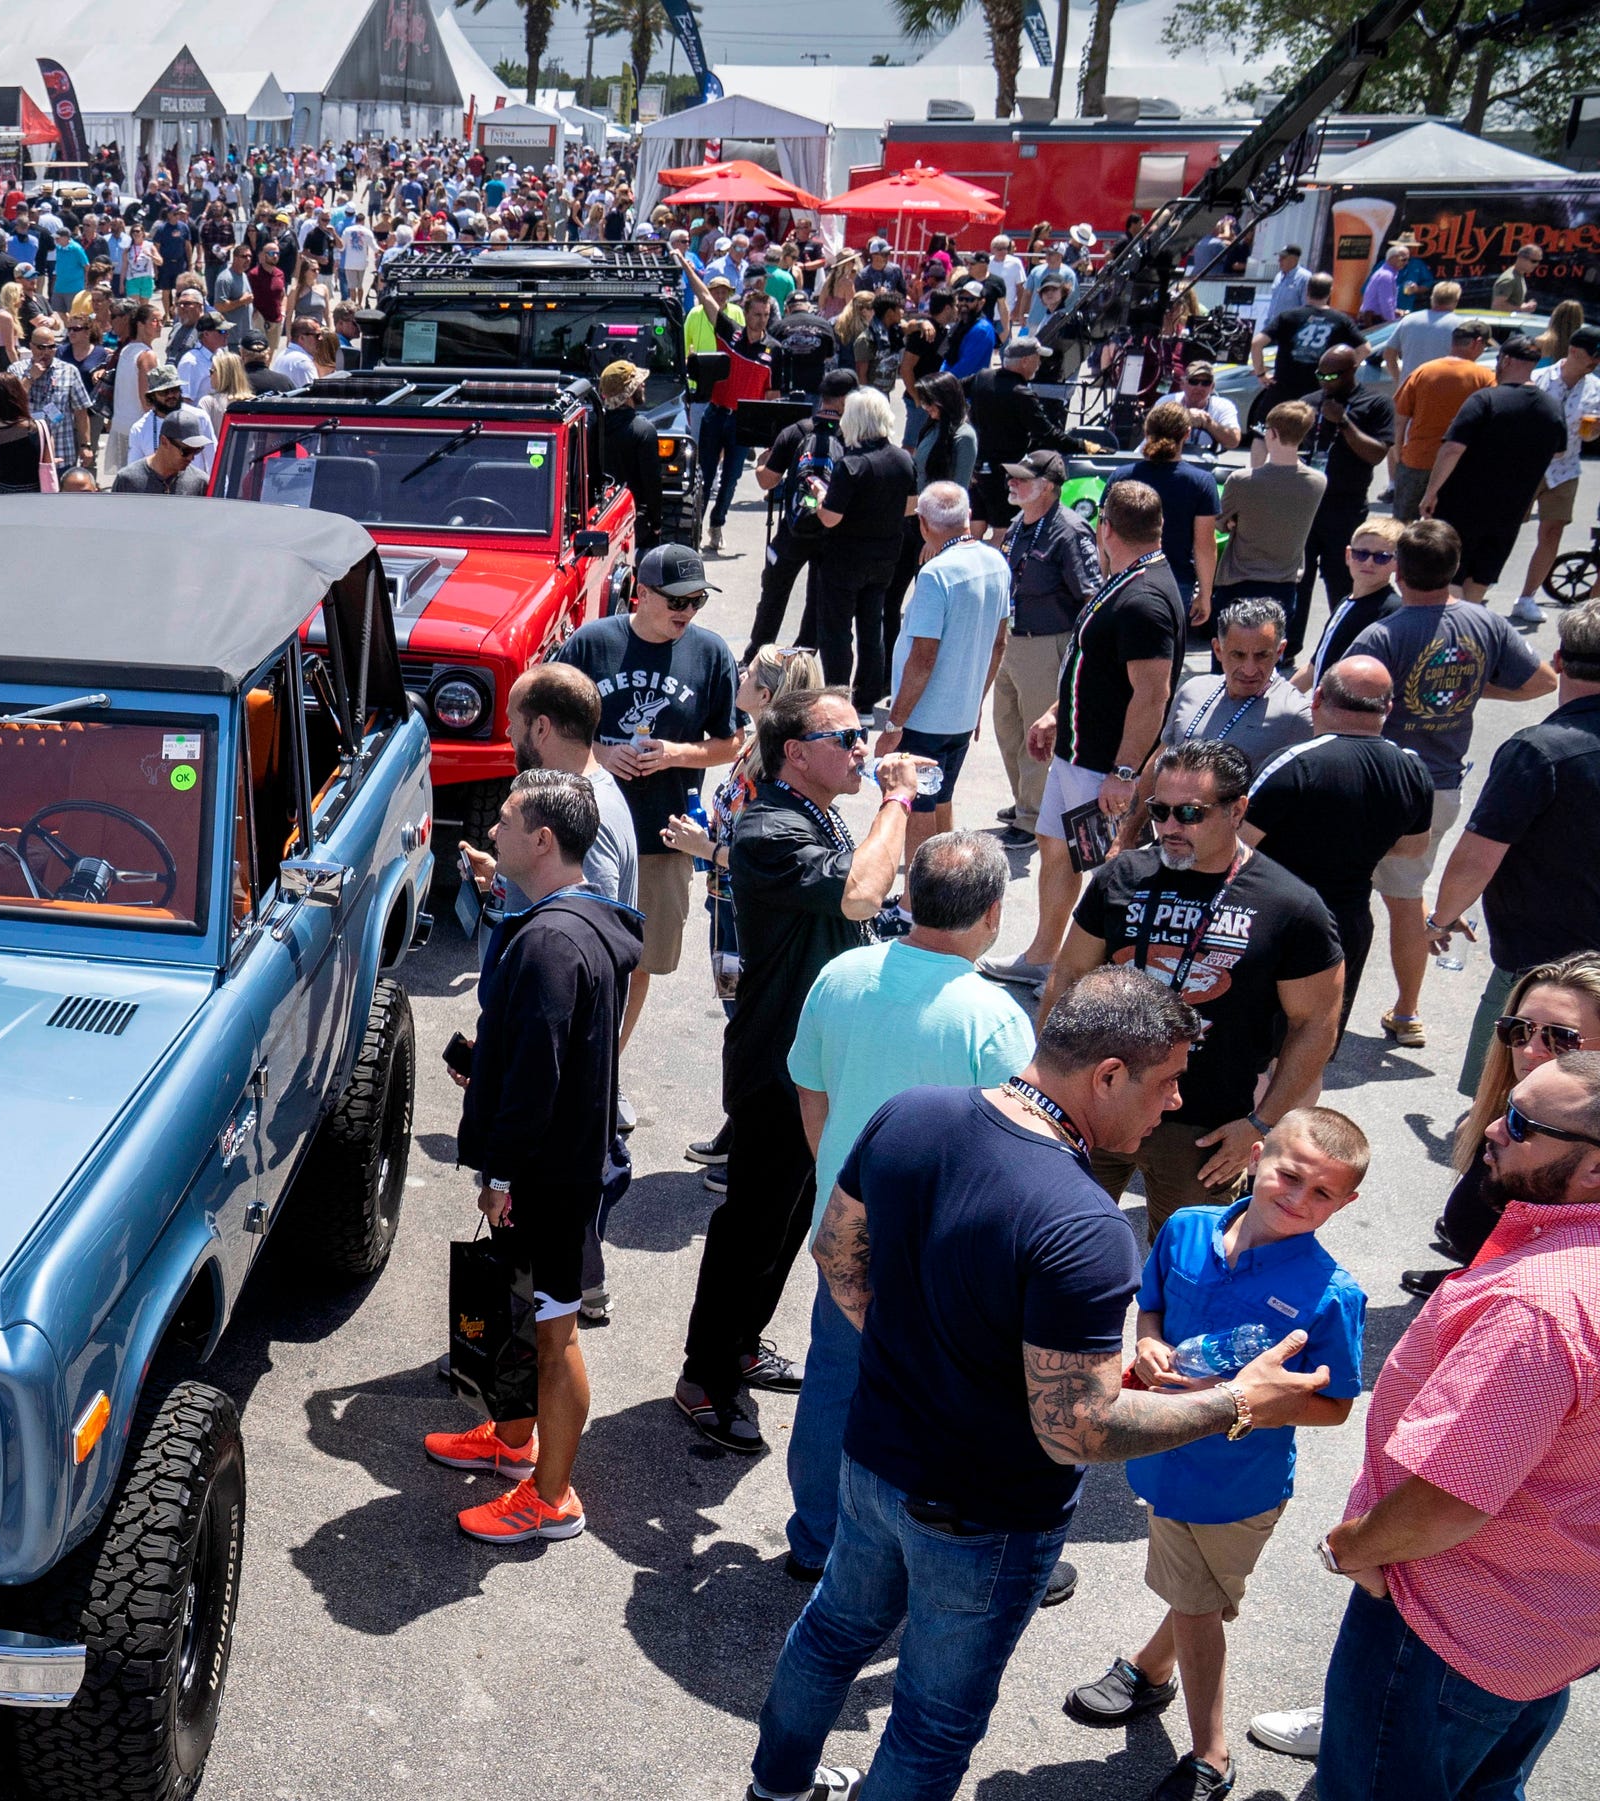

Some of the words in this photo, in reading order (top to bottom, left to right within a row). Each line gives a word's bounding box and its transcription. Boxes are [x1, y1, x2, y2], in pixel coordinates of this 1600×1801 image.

[1409, 208, 1503, 264] Billy
[1427, 264, 1486, 278] REW
[1298, 324, 1332, 348] 43
[597, 670, 695, 703] RESIST
[176, 773, 190, 783] OK
[1124, 926, 1188, 944] Syle!
[1206, 958, 1232, 968] 1974
[1209, 951, 1237, 962] SINCE
